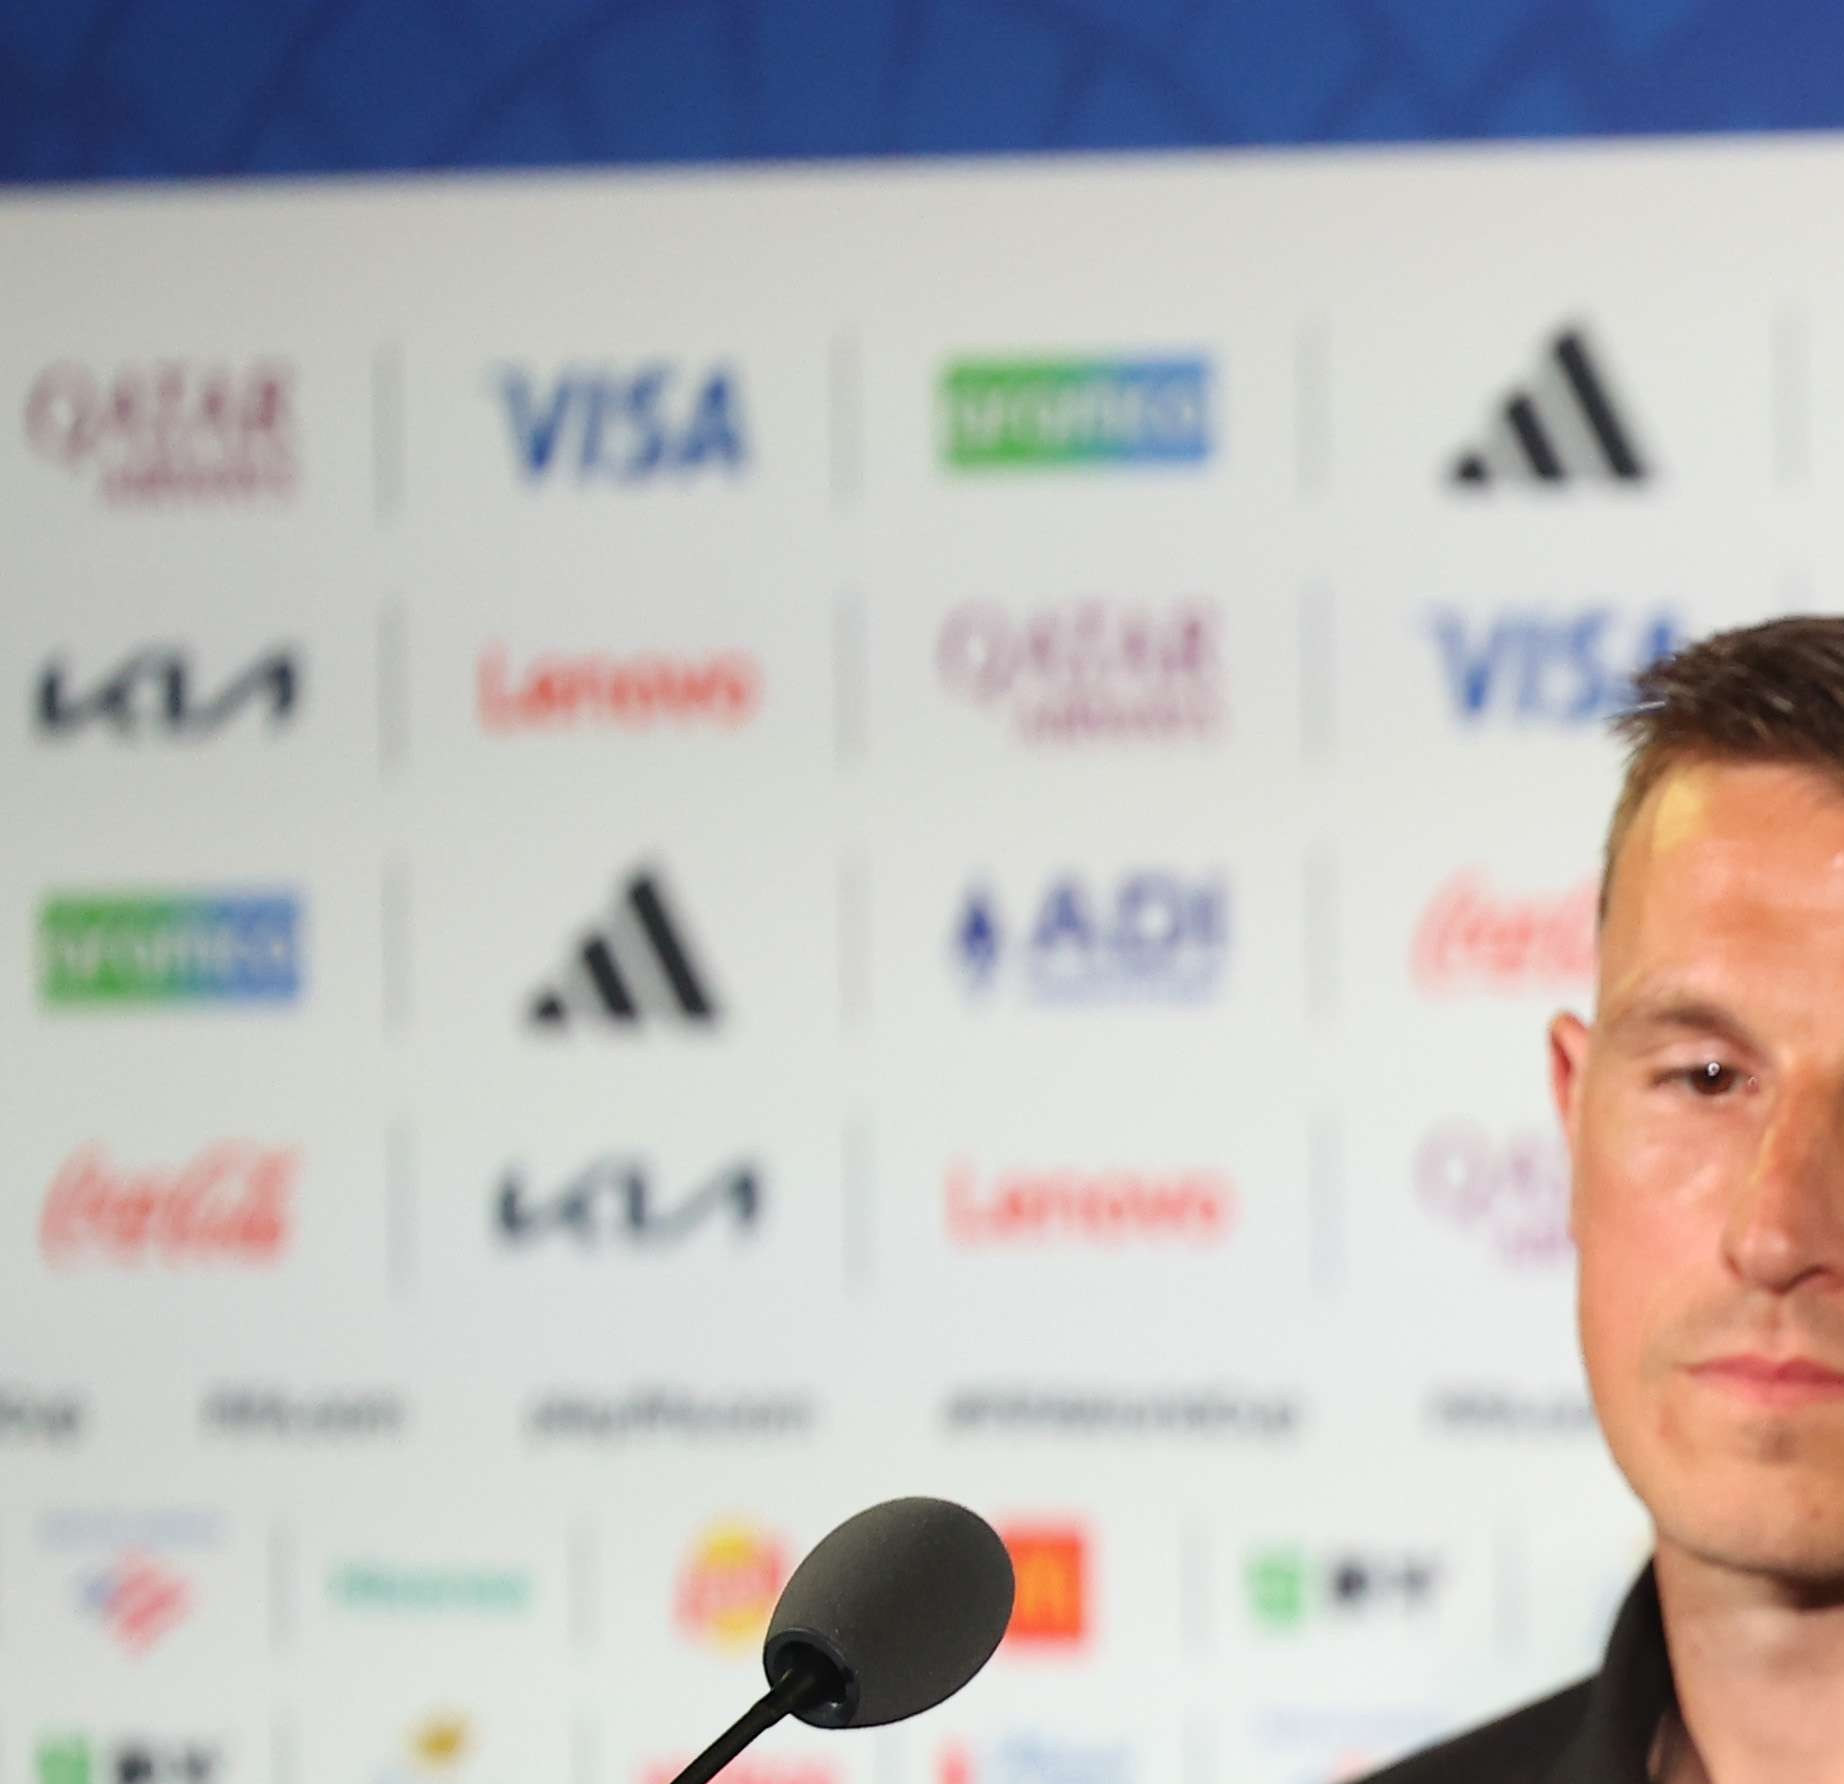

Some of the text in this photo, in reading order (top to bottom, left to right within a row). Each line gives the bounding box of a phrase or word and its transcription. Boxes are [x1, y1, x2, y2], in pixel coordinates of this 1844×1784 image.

[498, 362, 750, 484] VISA
[475, 650, 760, 733] Lenovo
[1034, 874, 1227, 950] ADI
[944, 1164, 1232, 1246] Lenovo
